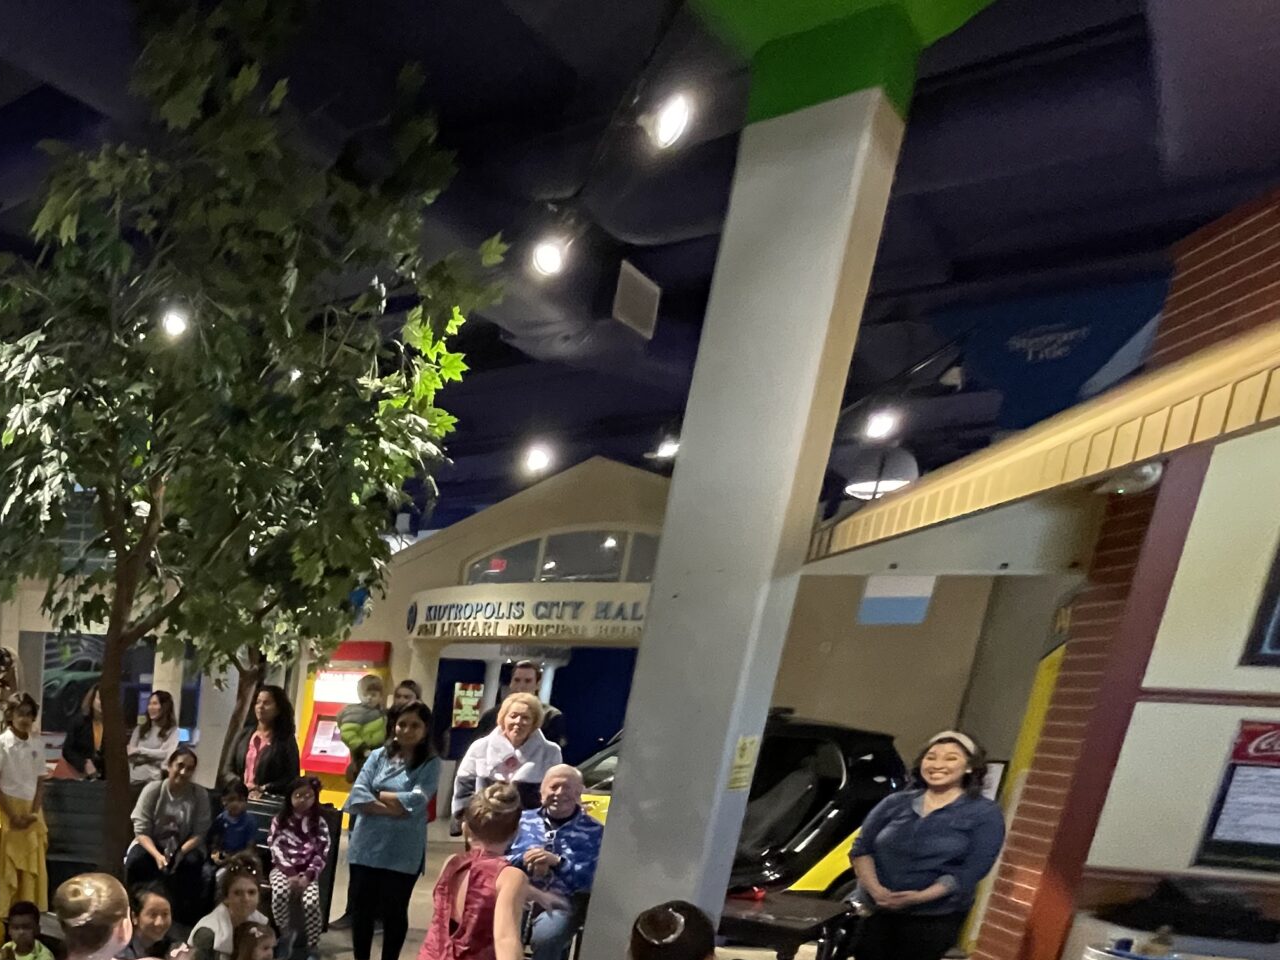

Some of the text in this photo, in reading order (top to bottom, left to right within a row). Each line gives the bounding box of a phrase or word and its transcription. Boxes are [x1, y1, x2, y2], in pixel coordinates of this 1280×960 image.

[425, 600, 644, 621] KIDTROPOLIS CITY HAL
